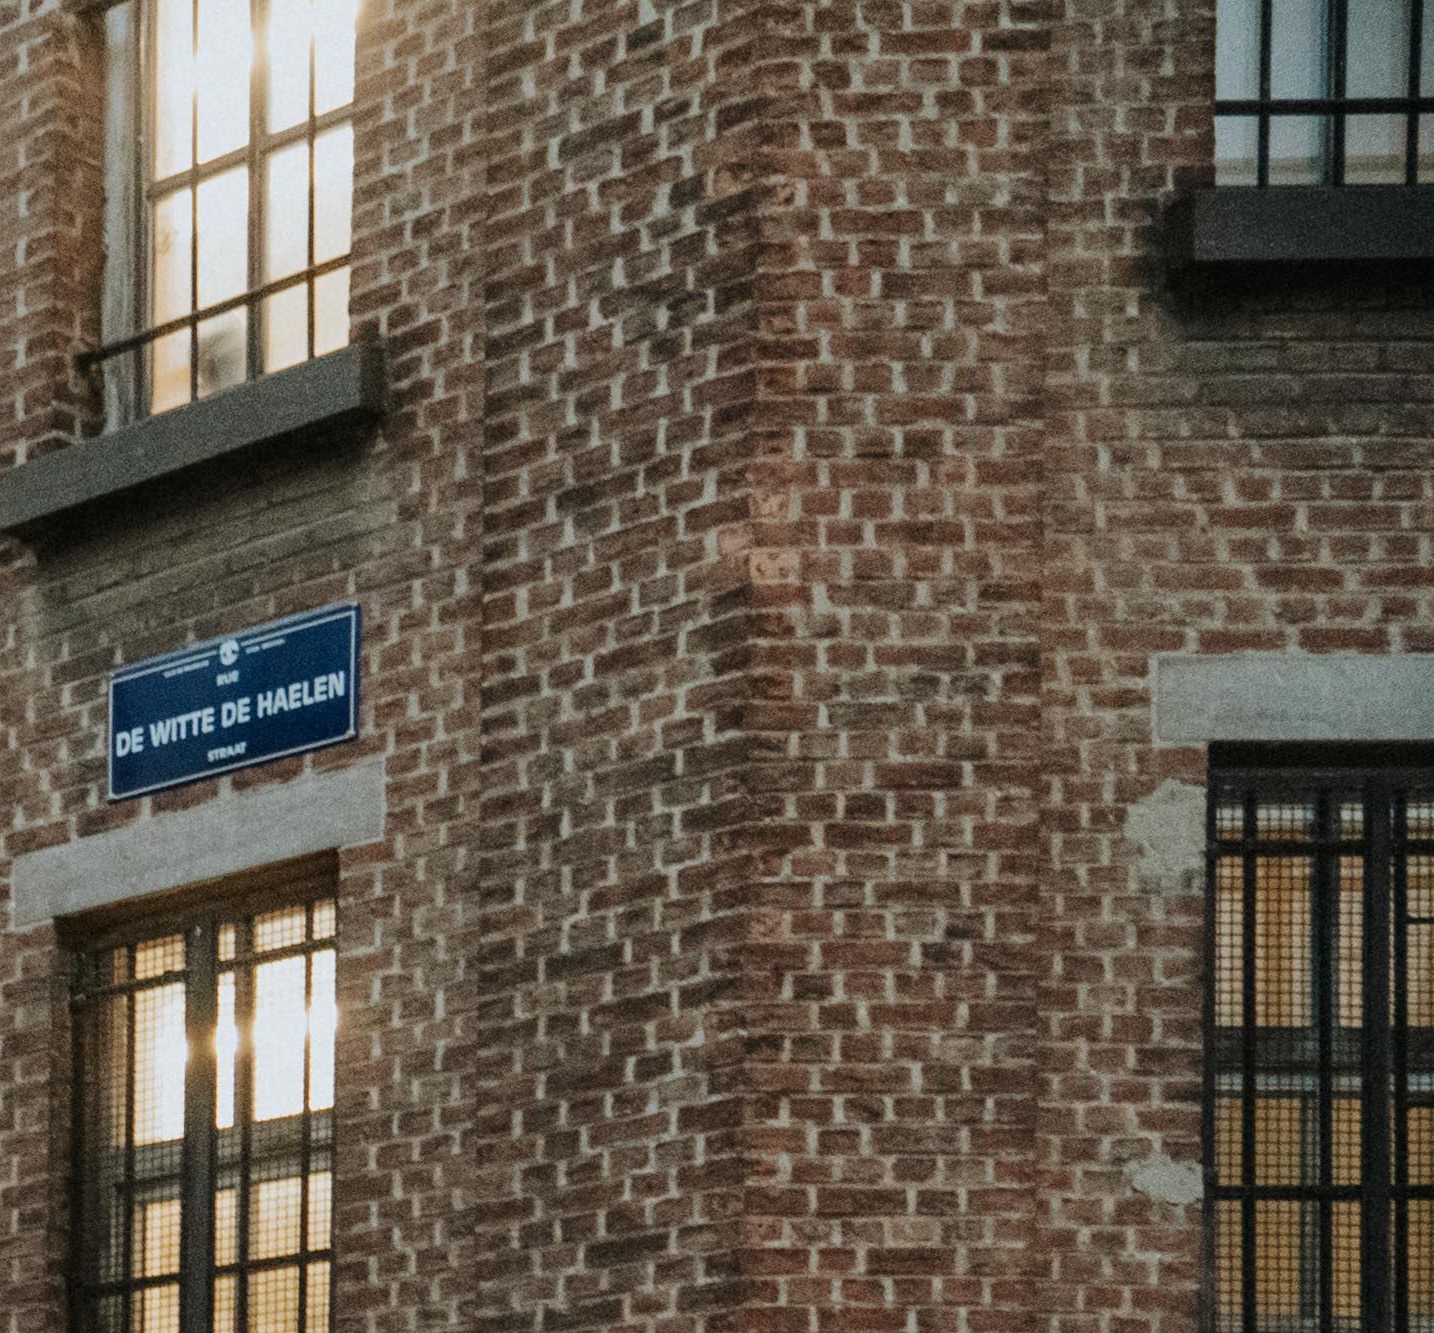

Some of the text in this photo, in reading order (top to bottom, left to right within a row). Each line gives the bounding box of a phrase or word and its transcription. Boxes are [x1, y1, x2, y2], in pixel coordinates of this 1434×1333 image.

[216, 670, 240, 687] RUE
[115, 670, 345, 758] DE WITTE DE HAELEN
[207, 742, 247, 763] STRAAT
